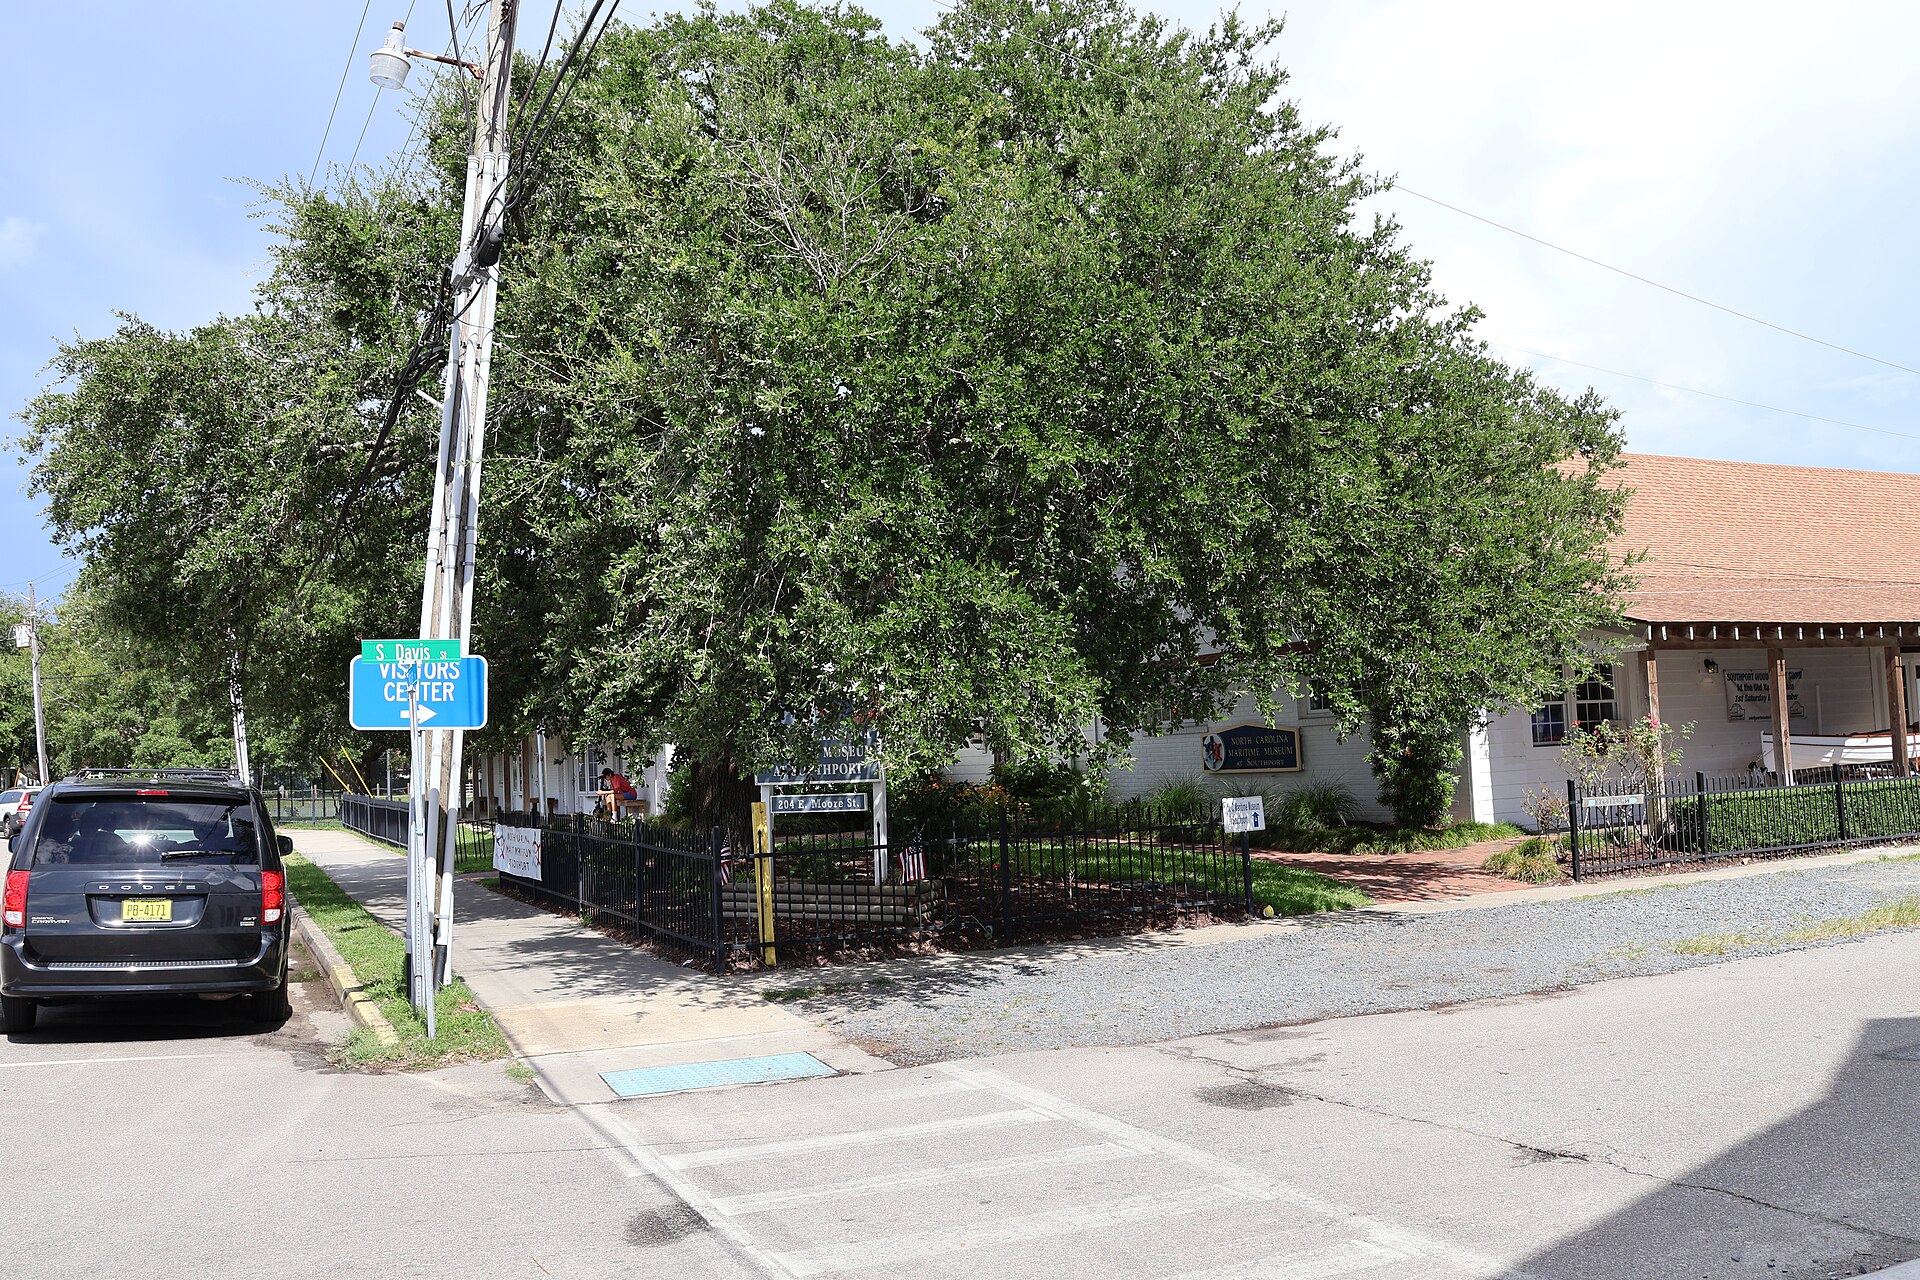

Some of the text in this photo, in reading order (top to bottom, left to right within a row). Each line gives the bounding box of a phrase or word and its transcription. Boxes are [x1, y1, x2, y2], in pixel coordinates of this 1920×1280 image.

[376, 643, 385, 661] S
[395, 643, 431, 661] Davis
[379, 661, 460, 680] VISORS
[1726, 672, 1754, 681] SOUTHPORT
[383, 681, 455, 702] CETER
[1744, 683, 1753, 692] the
[1754, 683, 1763, 692] Old
[1735, 694, 1744, 702] 1st
[1745, 693, 1767, 703] Saturday
[1231, 734, 1289, 746] NORTH CAROLINA
[1228, 746, 1293, 758] MARITIME MUSEUM
[778, 798, 860, 809] 204 E. Moore St.
[127, 904, 166, 917] PB-4171
